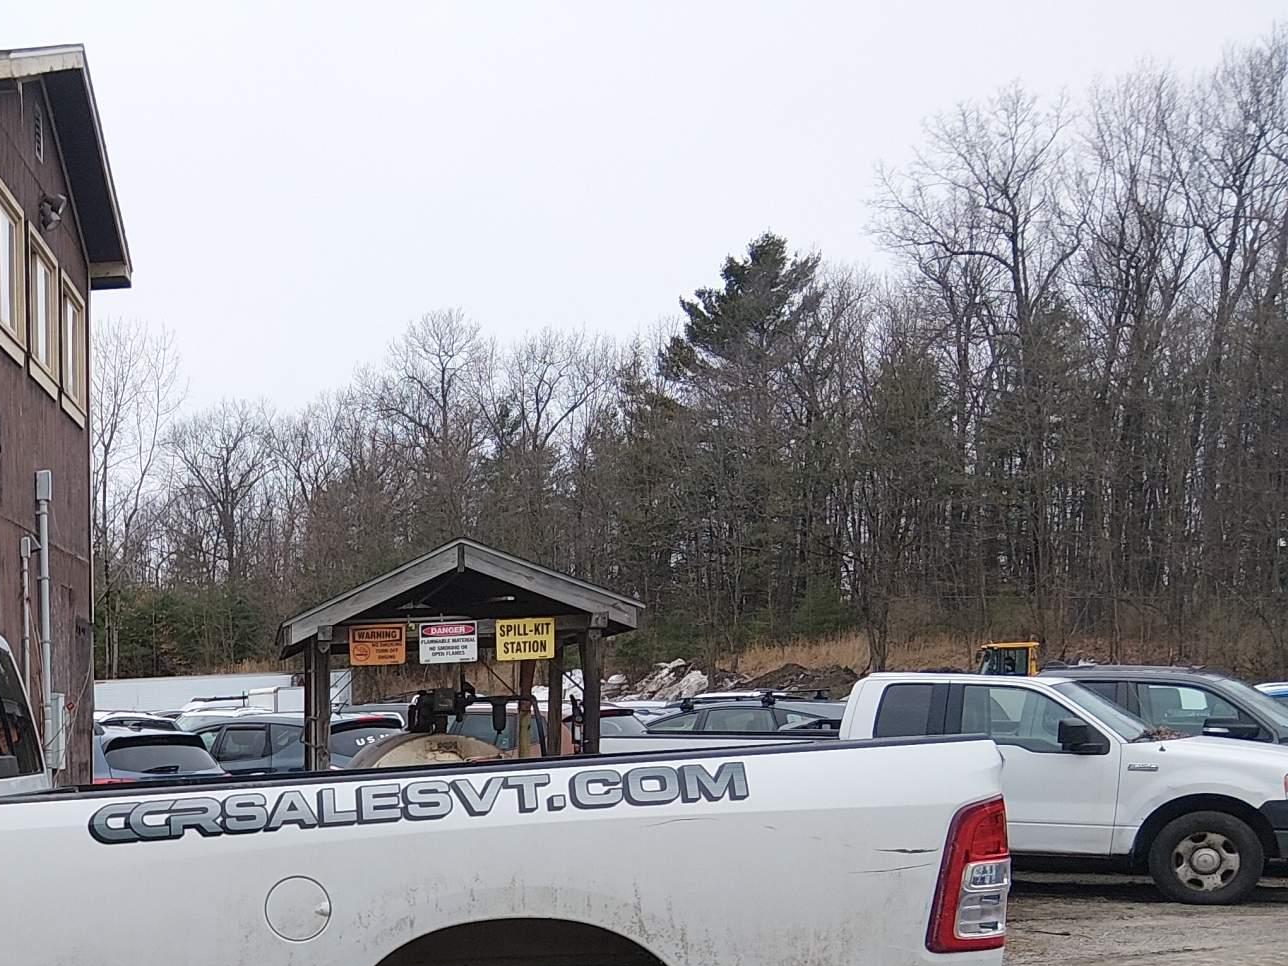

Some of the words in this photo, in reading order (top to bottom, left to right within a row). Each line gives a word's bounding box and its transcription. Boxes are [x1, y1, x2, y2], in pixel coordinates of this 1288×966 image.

[357, 630, 397, 640] WARNING
[431, 626, 466, 634] DANGER
[499, 622, 552, 637] SPILL-KIT
[503, 640, 547, 654] STATION
[88, 761, 750, 845] CCRSALESVT.COM
